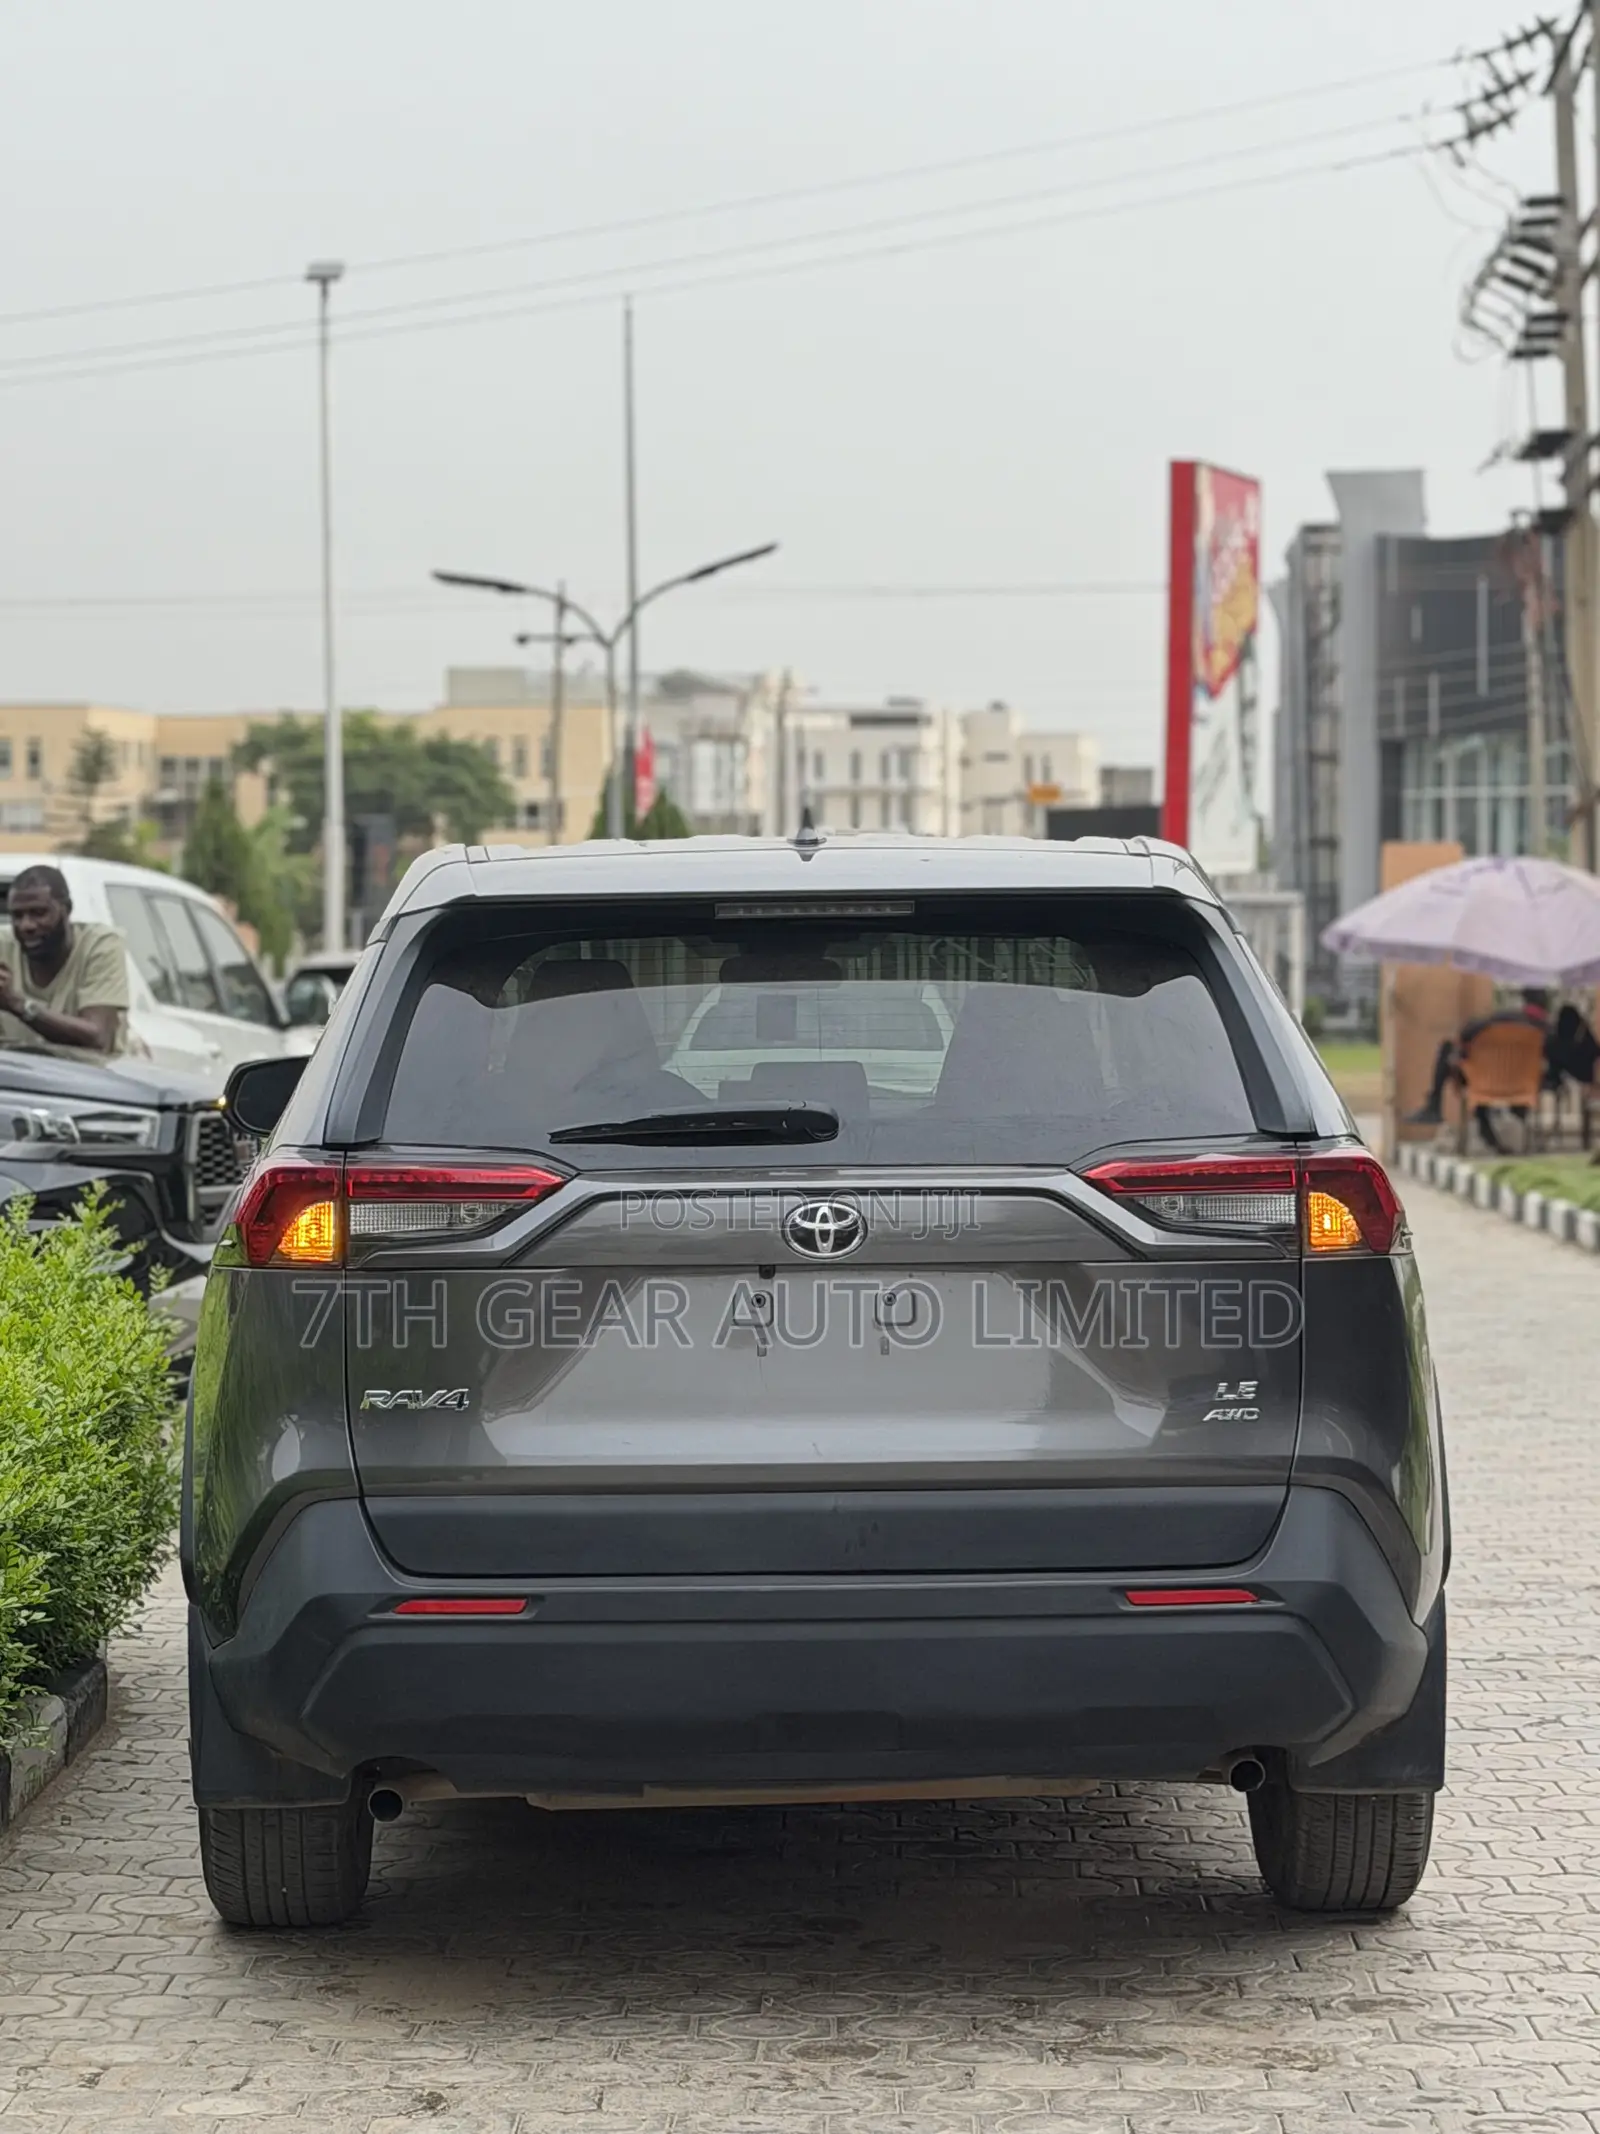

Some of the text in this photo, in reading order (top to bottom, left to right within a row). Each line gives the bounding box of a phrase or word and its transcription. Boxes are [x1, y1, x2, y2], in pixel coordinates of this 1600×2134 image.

[360, 1388, 470, 1411] RAV4
[1214, 1381, 1259, 1401] LE
[1202, 1407, 1261, 1421] AWD
